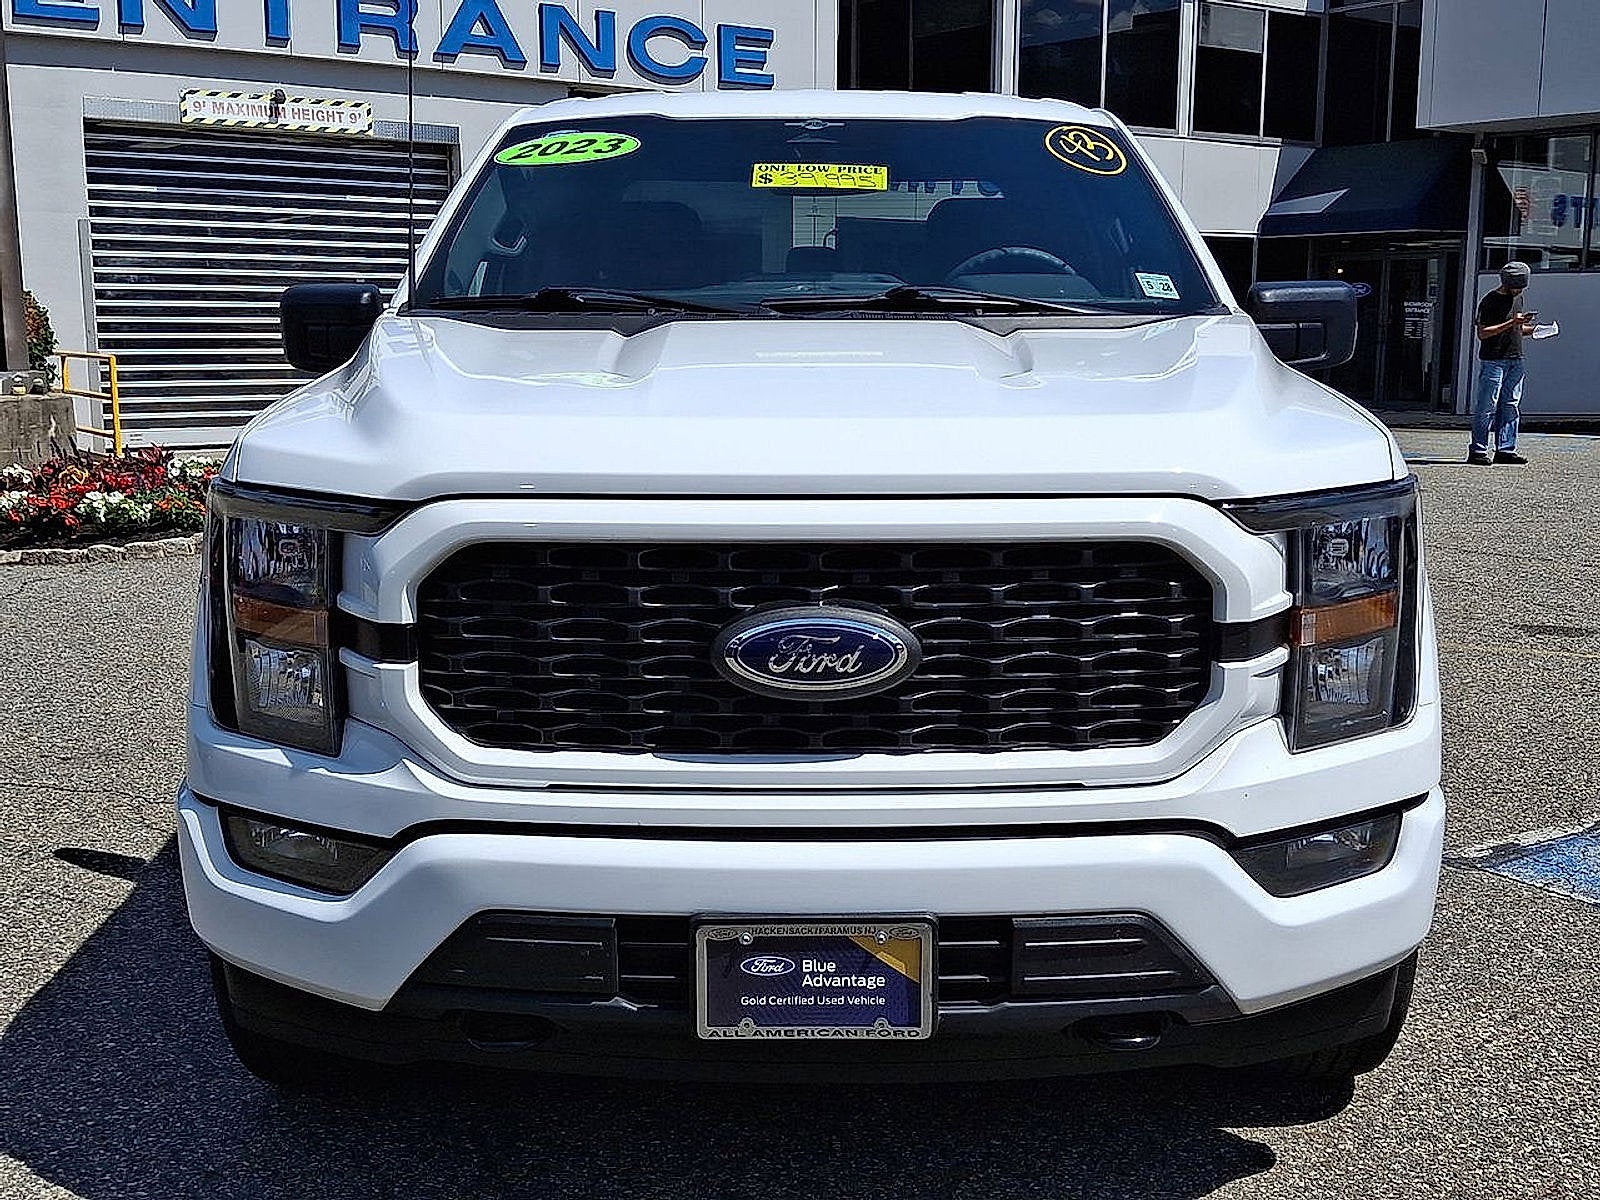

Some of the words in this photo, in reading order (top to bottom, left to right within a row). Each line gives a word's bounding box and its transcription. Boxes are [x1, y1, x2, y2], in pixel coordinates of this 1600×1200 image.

[211, 102, 287, 119] MAXIMUM
[291, 107, 345, 124] HEIGHT
[506, 137, 627, 161] 2023
[757, 164, 790, 172] ONE
[837, 165, 883, 175] PRICE
[768, 634, 866, 674] Ford
[750, 957, 785, 974] Ford
[801, 959, 837, 973] Blue
[801, 974, 886, 990] Advantage
[740, 995, 767, 1006] Gold
[768, 995, 815, 1006] Certified
[816, 995, 845, 1006] Used
[846, 995, 886, 1006] Vehicle
[708, 1029, 747, 1038] ALL
[752, 1028, 858, 1038] AMERICAN
[865, 1029, 920, 1038] FORD
